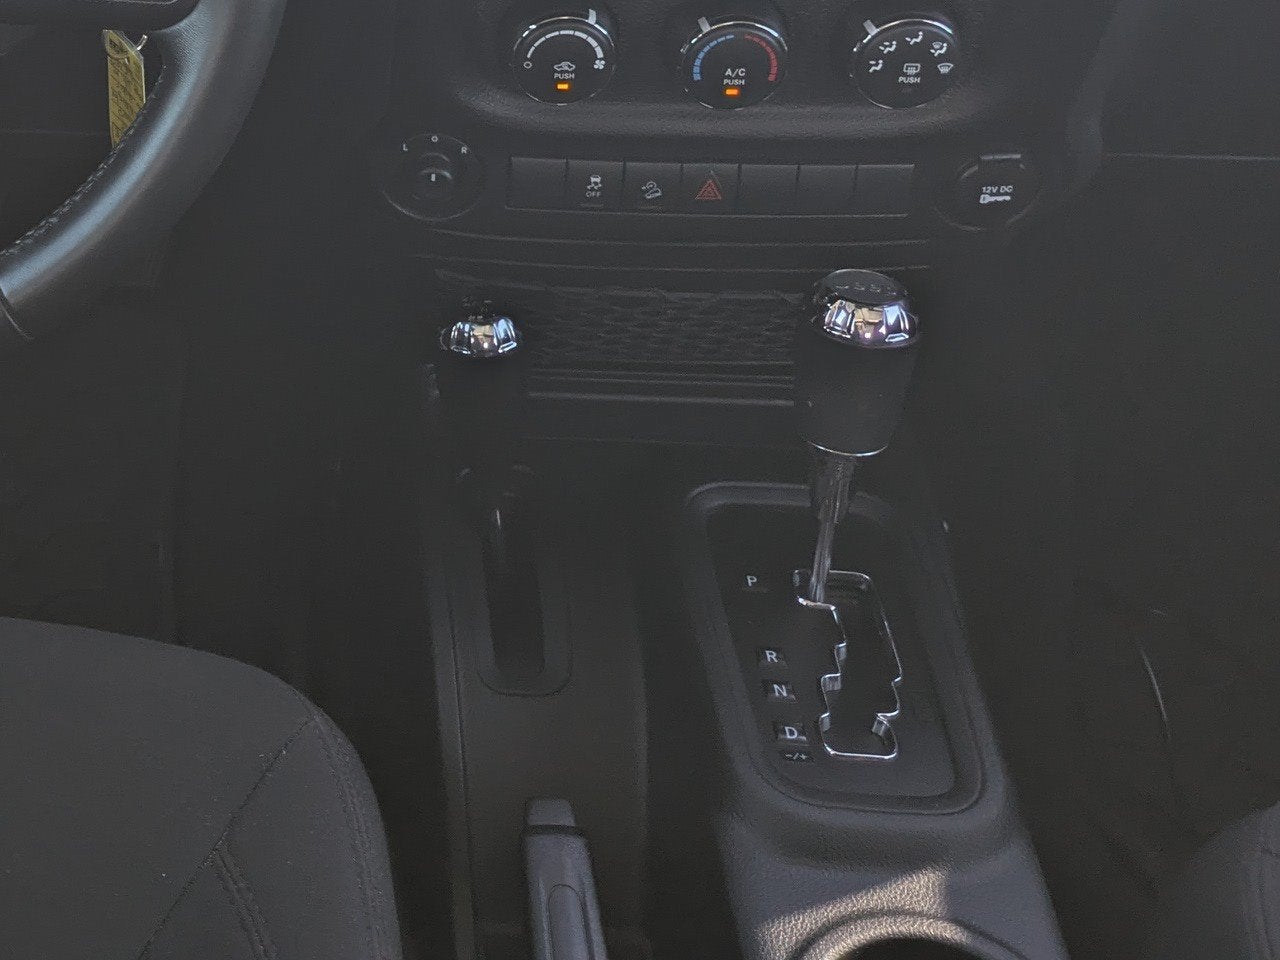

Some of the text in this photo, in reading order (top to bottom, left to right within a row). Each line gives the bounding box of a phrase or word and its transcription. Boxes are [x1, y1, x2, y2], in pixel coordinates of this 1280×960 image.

[724, 67, 745, 77] A/C
[723, 78, 745, 86] PUSH
[402, 144, 408, 152] L
[461, 146, 468, 154] R
[585, 190, 601, 198] OFF
[746, 575, 757, 586] P
[765, 649, 778, 663] R
[773, 683, 787, 697] N
[784, 726, 798, 739] D
